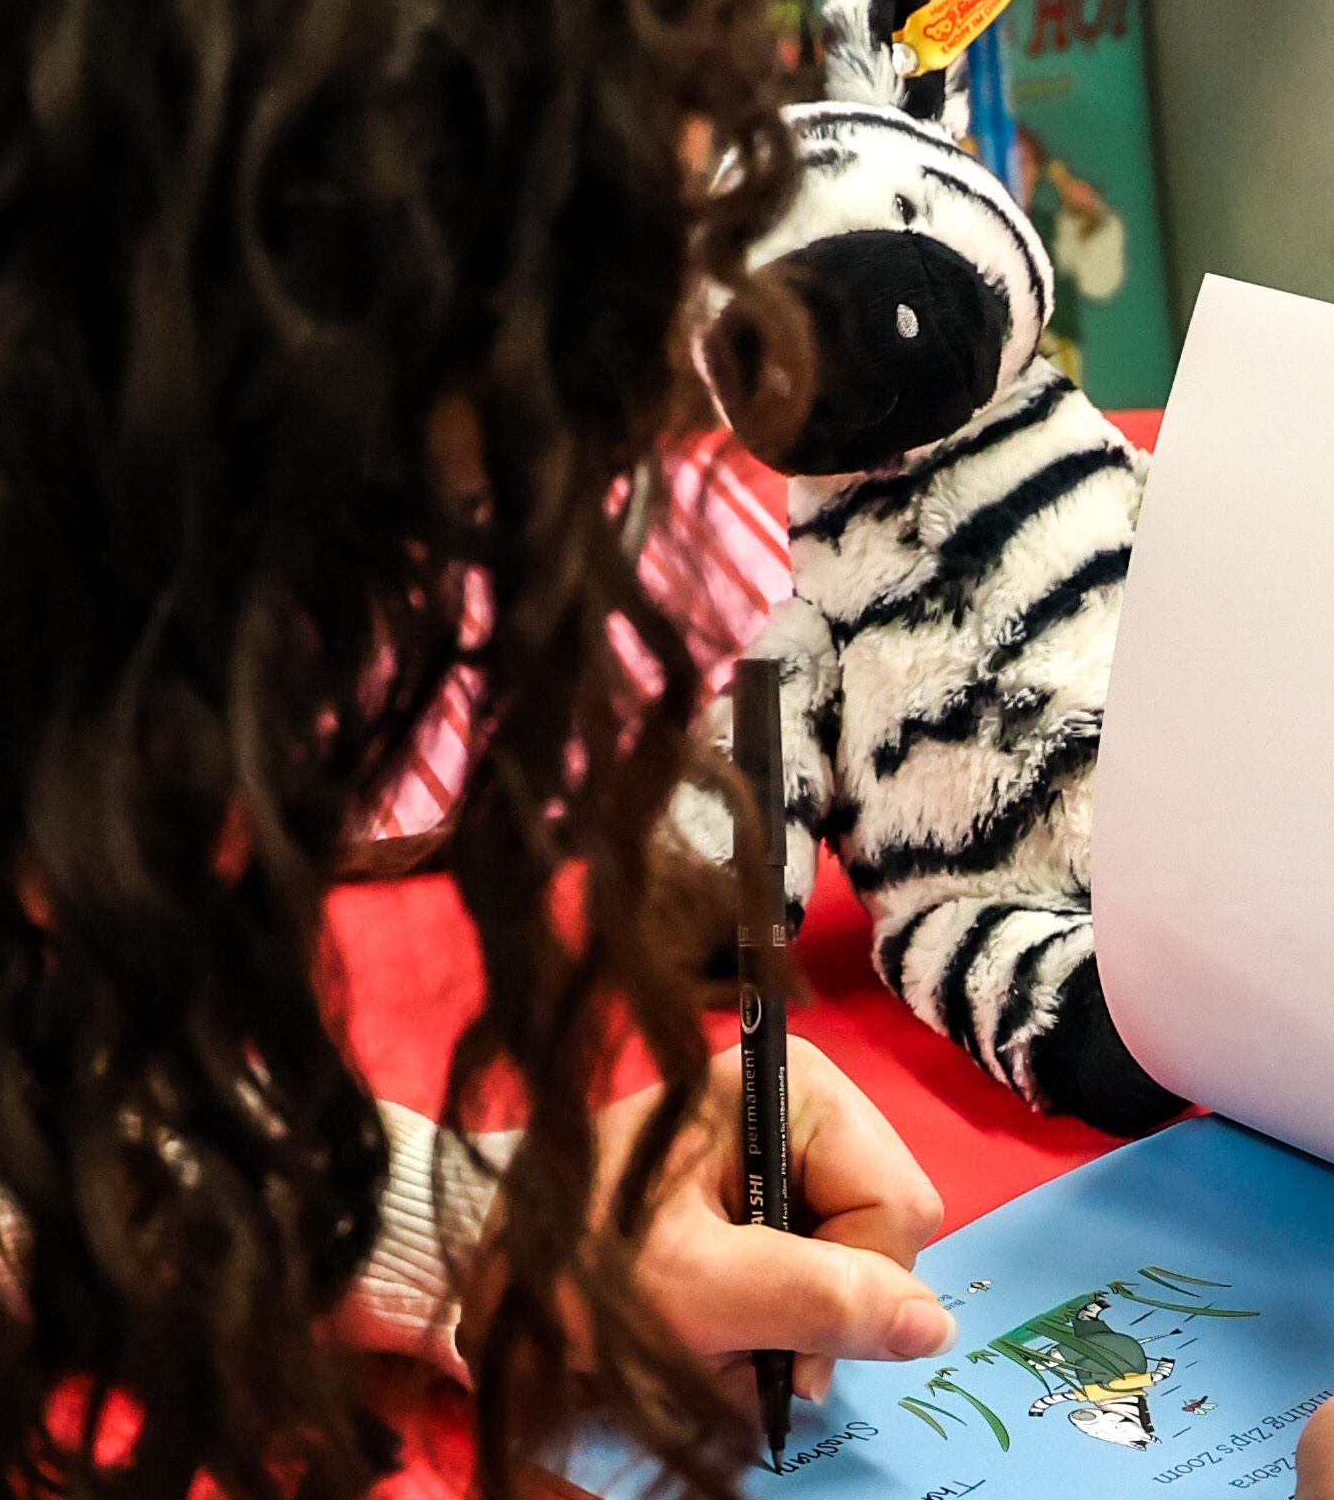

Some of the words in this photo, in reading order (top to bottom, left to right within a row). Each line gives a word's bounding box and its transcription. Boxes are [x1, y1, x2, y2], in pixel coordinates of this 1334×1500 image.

[744, 1049, 763, 1155] permanent
[1215, 1426, 1273, 1455] Zip's
[1152, 1451, 1223, 1485] Zoom
[1228, 1457, 1297, 1490] Zebra
